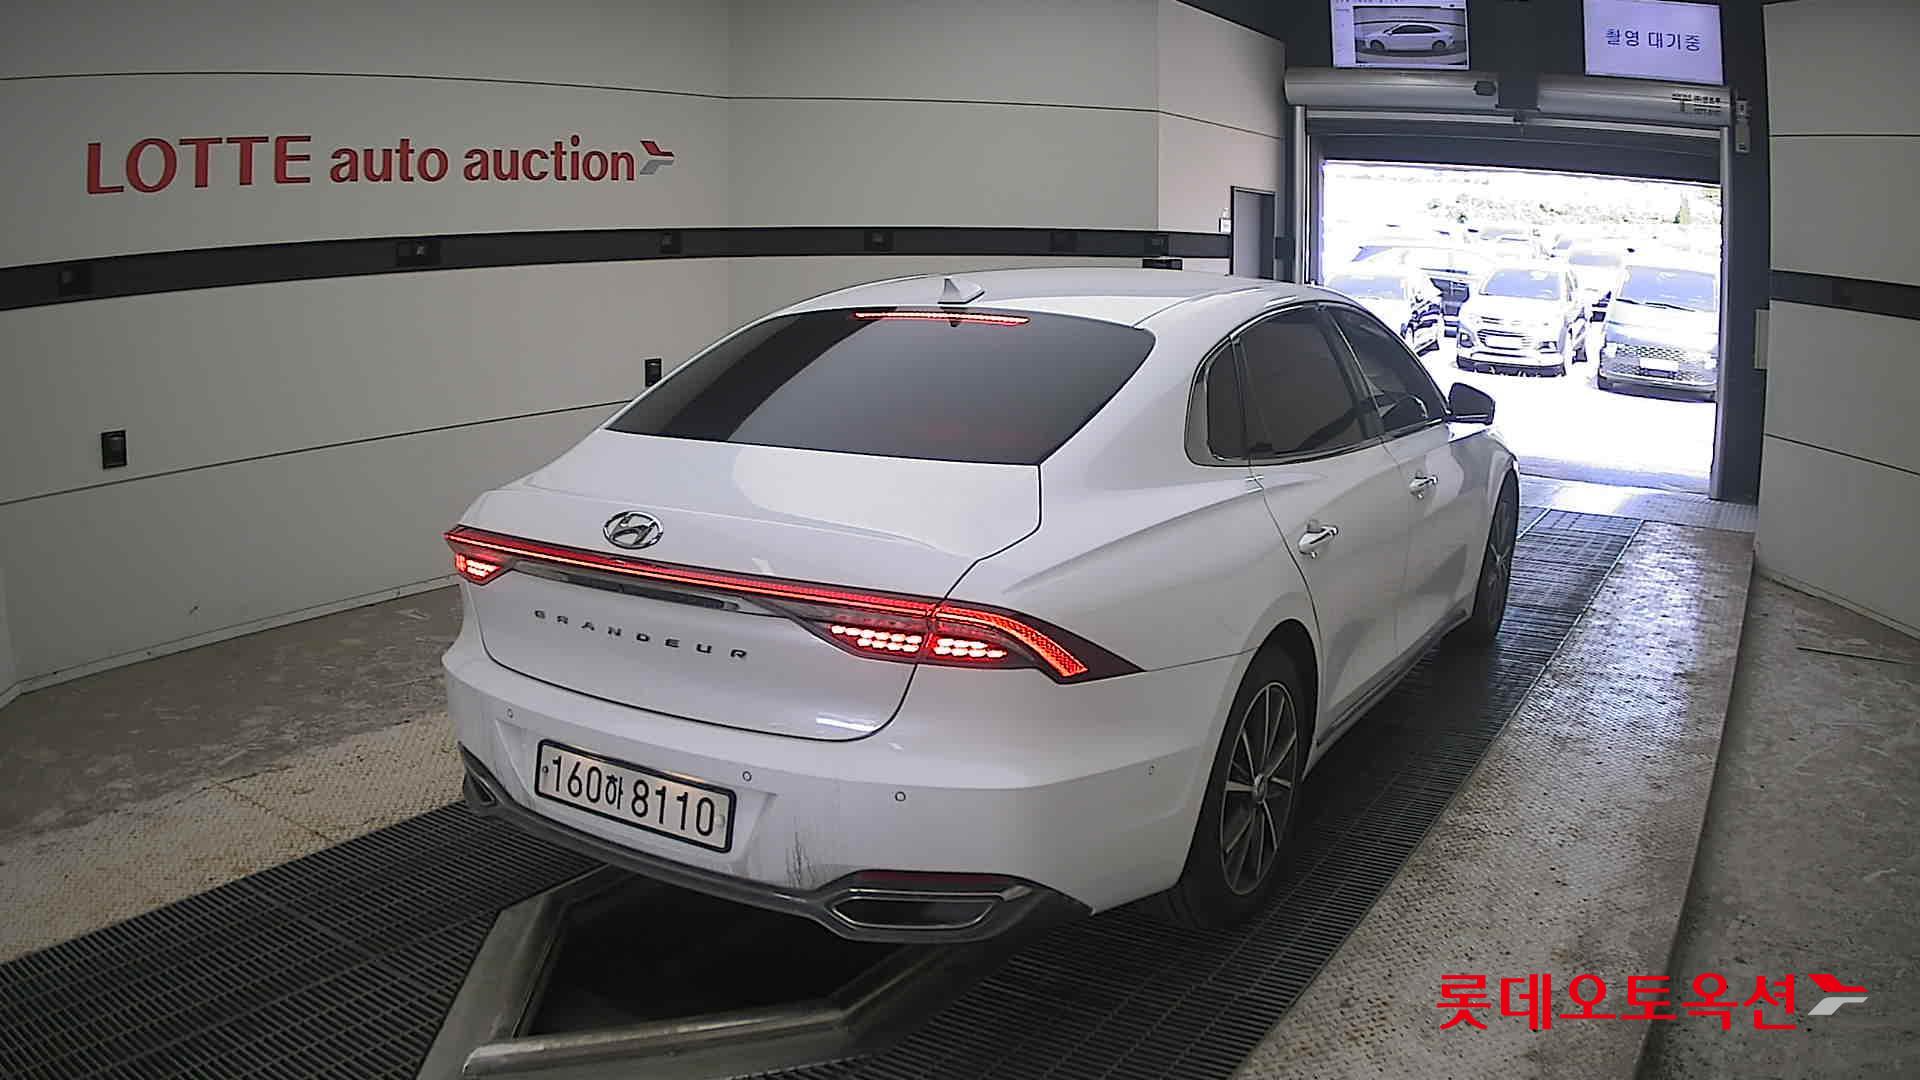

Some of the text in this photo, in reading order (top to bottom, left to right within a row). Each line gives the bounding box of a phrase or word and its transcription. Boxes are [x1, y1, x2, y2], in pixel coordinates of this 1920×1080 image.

[1647, 31, 1701, 52] 대기중
[87, 135, 635, 194] LOTTE auto auction
[534, 609, 747, 659] GRANDEUR
[631, 779, 715, 837] 8110
